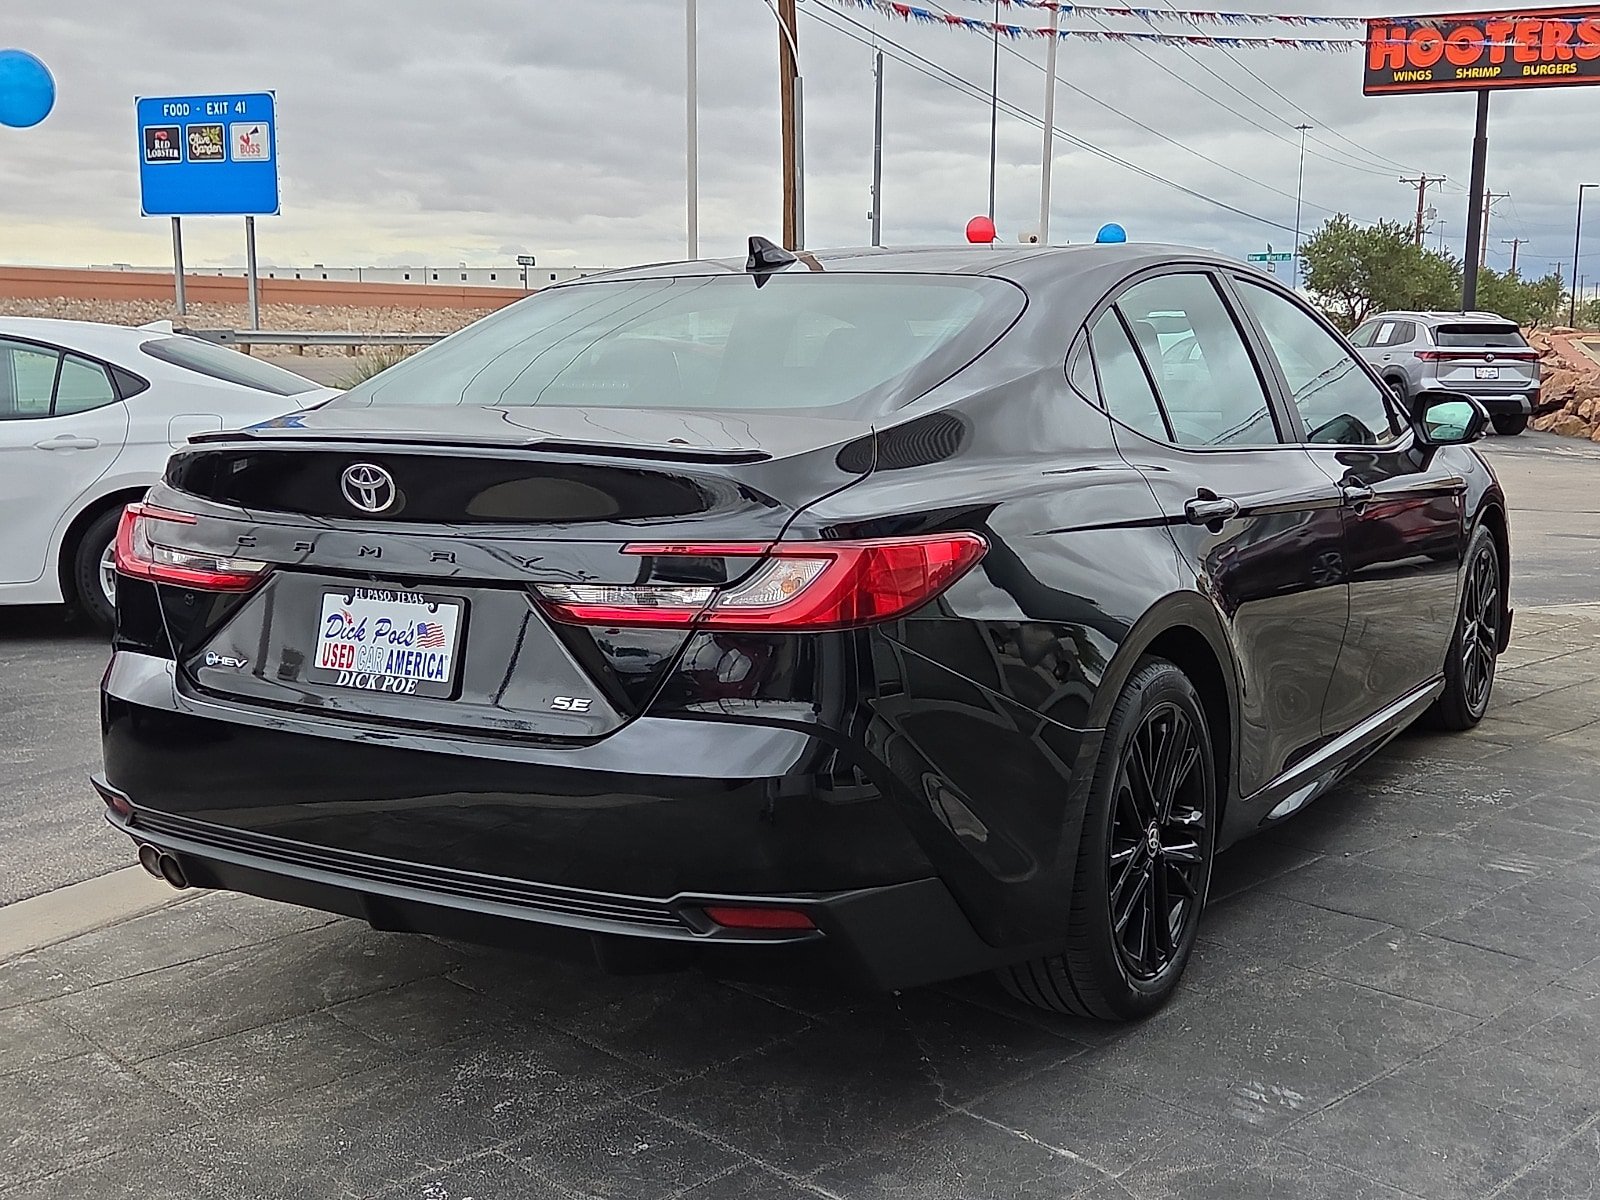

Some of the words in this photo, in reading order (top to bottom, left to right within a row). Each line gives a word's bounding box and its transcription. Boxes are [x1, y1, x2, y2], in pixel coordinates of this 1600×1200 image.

[1369, 21, 1600, 70] HOOTERS
[1393, 70, 1432, 81] WINGS
[1455, 67, 1501, 79] SHRIMP
[1522, 63, 1578, 76] BURGERS
[163, 104, 190, 117] FOOD
[206, 102, 229, 115] EXIT
[235, 101, 246, 114] 41
[189, 133, 210, 145] Olive
[147, 148, 179, 158] LOBSTER
[192, 143, 222, 156] Garden
[240, 143, 260, 154] BOSS
[237, 536, 543, 568] CAMRY
[354, 588, 365, 599] EL
[396, 592, 424, 604] TEXAS
[325, 614, 367, 642] Dick
[372, 618, 415, 646] Poe's
[322, 643, 355, 668] USED
[357, 645, 384, 673] CAR
[385, 650, 444, 679] AMERICA
[336, 671, 377, 691] DICK
[380, 676, 418, 694] POE
[550, 696, 593, 712] SE
